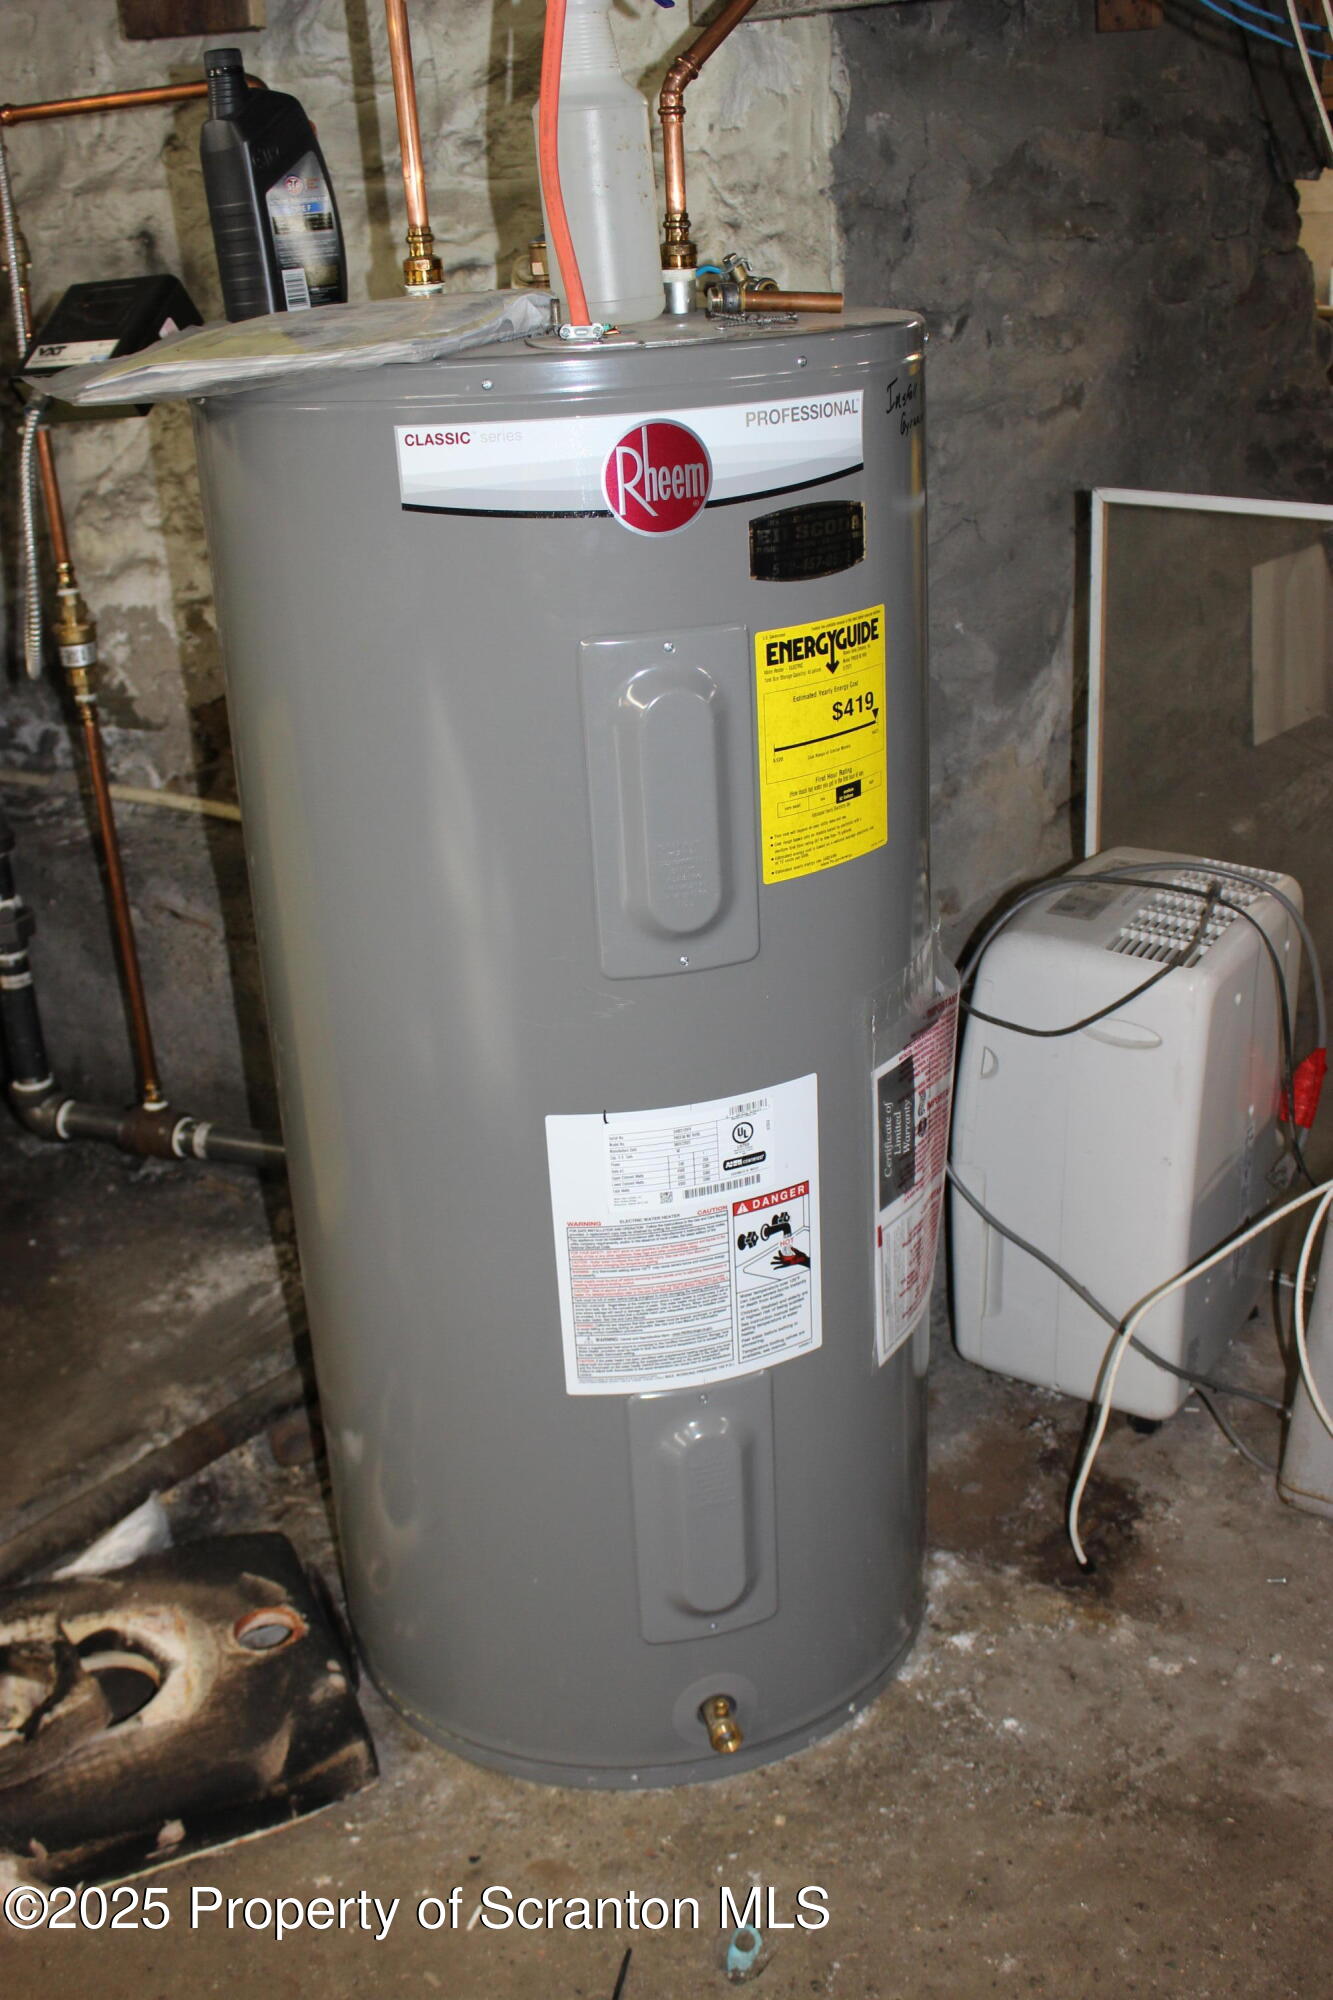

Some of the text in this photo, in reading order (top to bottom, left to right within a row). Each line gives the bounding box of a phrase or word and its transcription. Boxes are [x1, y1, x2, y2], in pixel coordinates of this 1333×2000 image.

[745, 398, 859, 428] PROFESSIONAL
[404, 430, 522, 447] CLASSIC series
[615, 426, 706, 517] Rheem
[766, 617, 879, 667] ENERGYGUIDE
[832, 691, 874, 721] $419
[737, 1126, 749, 1139] UL
[883, 1101, 894, 1178] Certificate of
[893, 1111, 902, 1155] Limited
[902, 1099, 912, 1154] Warranty
[697, 1205, 728, 1215] CAUTION
[752, 1185, 806, 1209] DANGER
[780, 1237, 795, 1247] HOT
